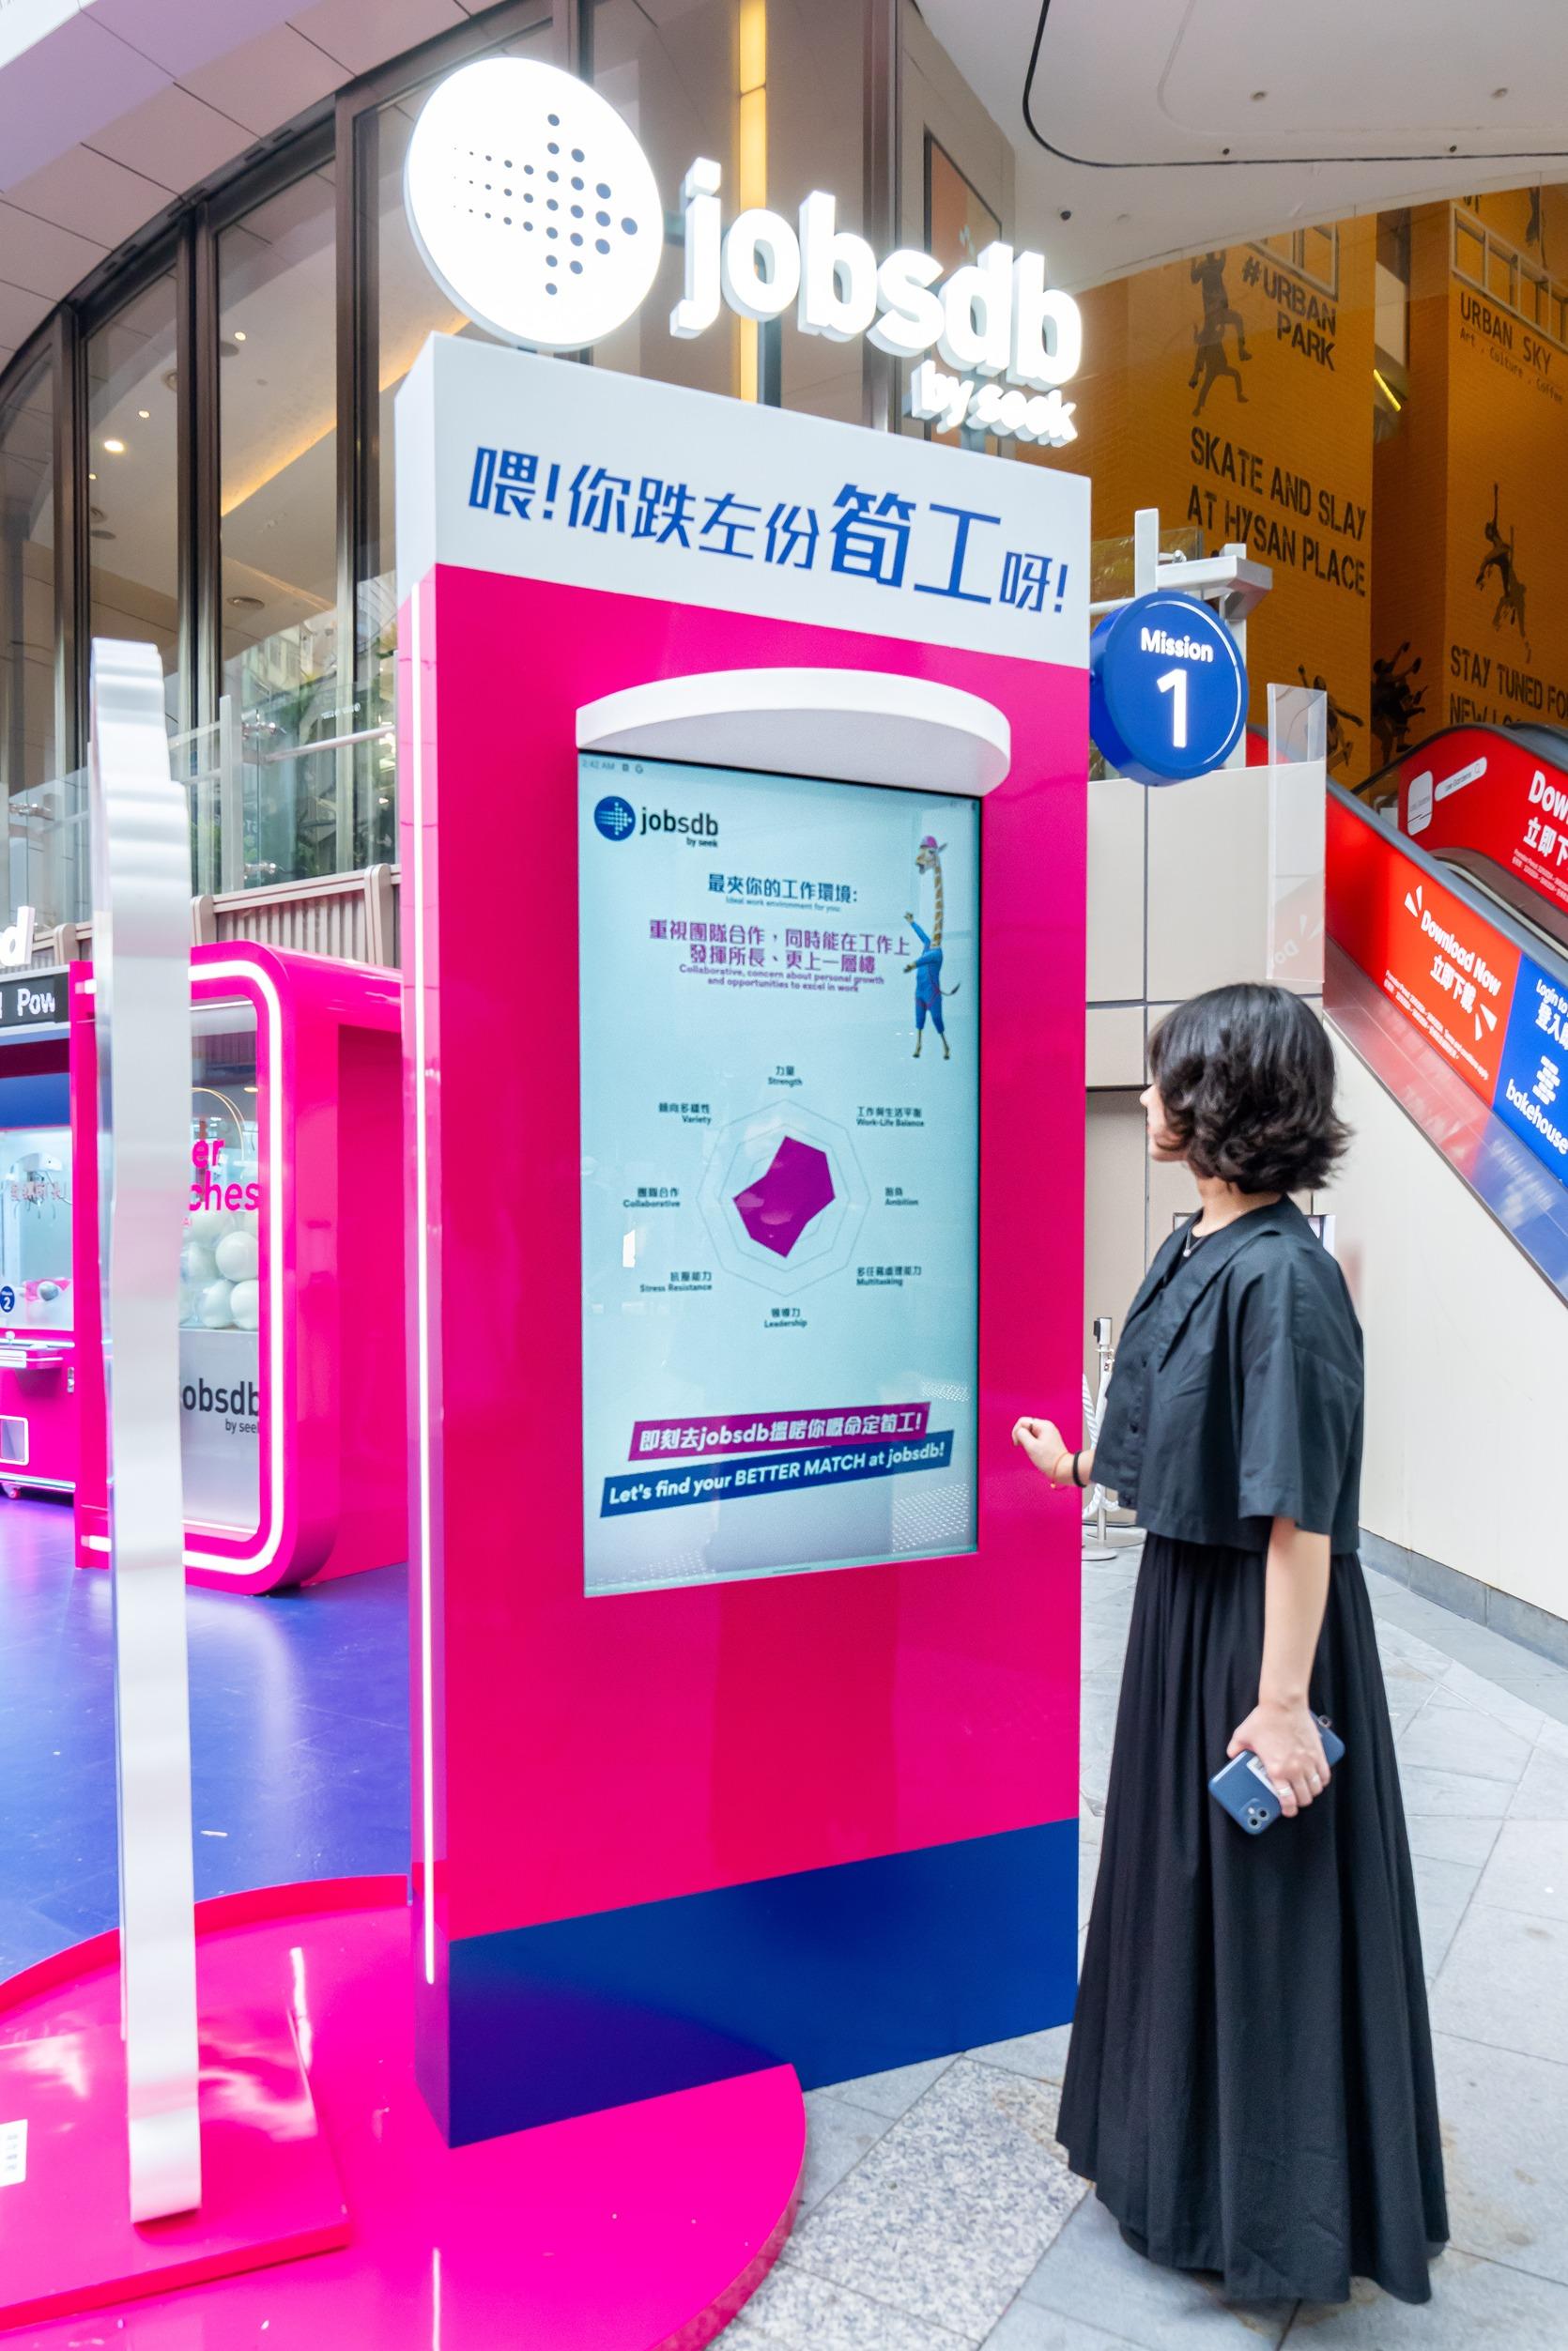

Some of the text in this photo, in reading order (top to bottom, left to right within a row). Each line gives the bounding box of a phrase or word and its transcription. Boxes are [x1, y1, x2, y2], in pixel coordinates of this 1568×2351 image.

[669, 156, 1082, 392] jobsdb
[1277, 311, 1335, 372] PARK
[1460, 292, 1551, 375] URBAN SKY
[1460, 327, 1476, 347] Art
[911, 359, 1078, 448] by seek
[1191, 425, 1367, 542] SKATE AND SLAY
[1188, 484, 1367, 597] AT HYSAN PLACE
[1141, 627, 1214, 662] Mission
[1450, 644, 1491, 688] STAY
[1497, 663, 1543, 710] TUNED
[1547, 684, 1568, 721] FO
[1156, 668, 1188, 748] 1
[1528, 770, 1568, 824] Dow
[639, 807, 719, 836] jobsdb
[686, 837, 718, 848] by seek
[1421, 909, 1501, 997] Download Now
[679, 963, 884, 986] Collaborative, concern about personal growth
[708, 977, 858, 993] and opportunities to excel in work
[1536, 978, 1559, 1006] Login
[768, 1077, 803, 1088] Strength
[682, 1114, 711, 1126] Variety
[856, 1118, 924, 1127] Work-Life Balance
[1506, 1079, 1568, 1155] bakehouse
[623, 1199, 680, 1208] Collaborative
[884, 1197, 918, 1206] Ambition
[639, 1283, 712, 1292] Stress Resistance
[856, 1278, 903, 1287] Multitasking
[4, 1297, 10, 1310] 2
[764, 1319, 807, 1329] Leadership
[225, 1418, 259, 1435] by see
[609, 1441, 945, 1504] Let's find your BETTER MATCH at jobsdb!
